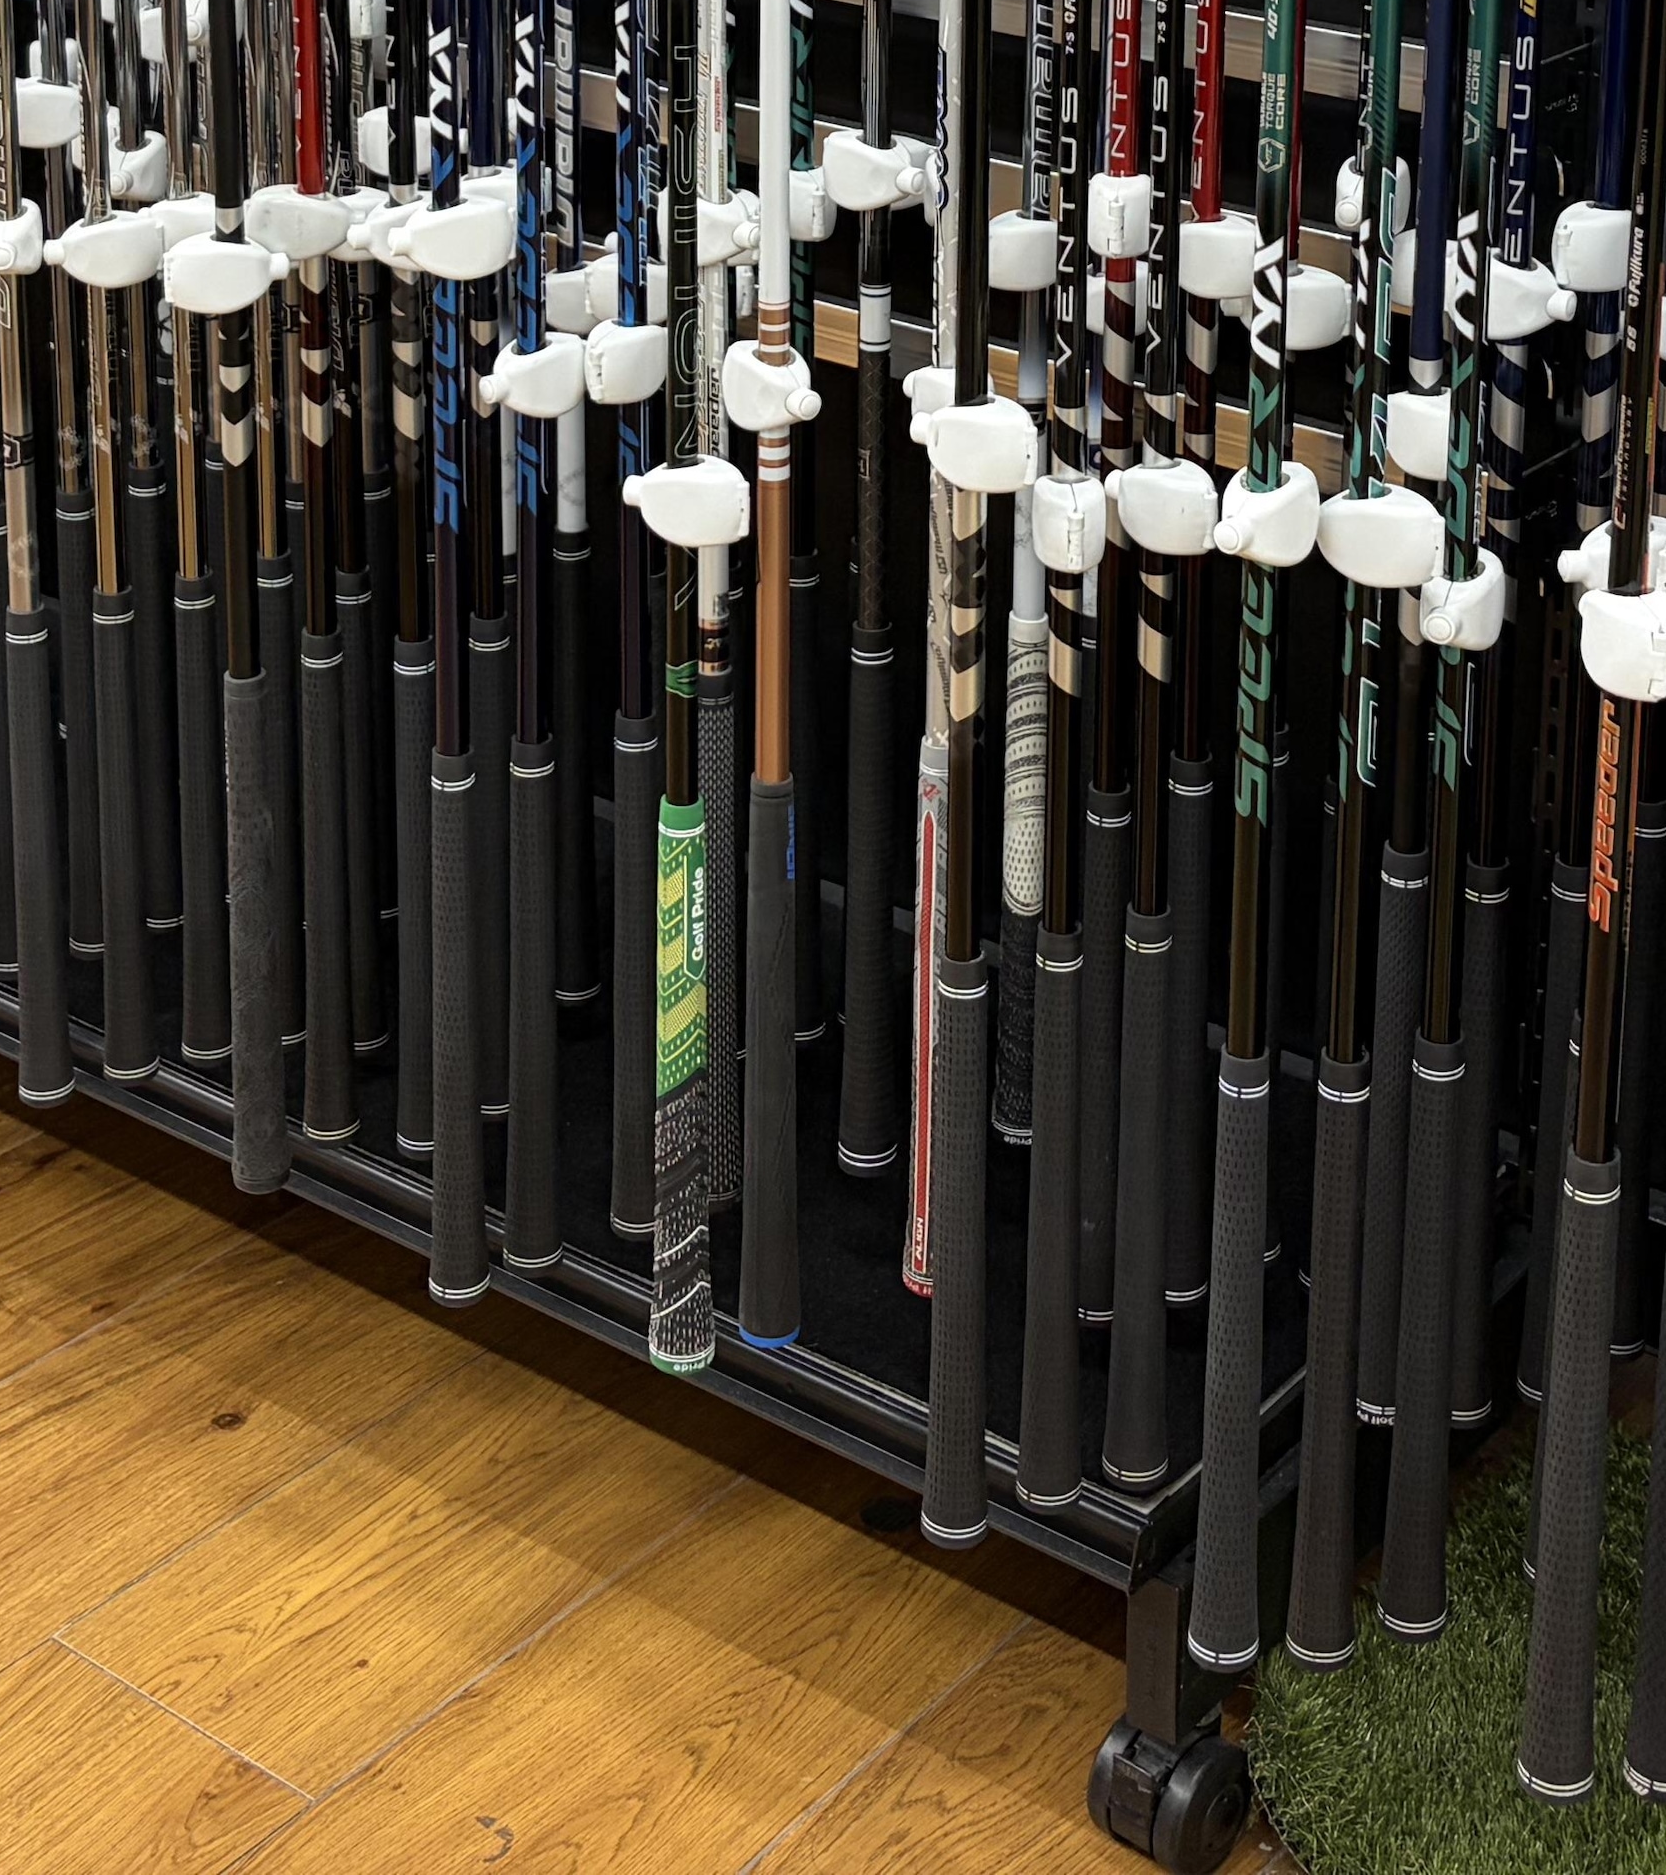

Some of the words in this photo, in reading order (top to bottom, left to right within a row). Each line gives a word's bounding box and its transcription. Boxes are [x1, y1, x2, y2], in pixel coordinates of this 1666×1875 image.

[1275, 73, 1287, 130] CORE
[1502, 34, 1534, 263] ENTUS
[1054, 86, 1078, 368] VENTUS
[1144, 75, 1169, 357] VENTUS
[1629, 226, 1644, 293] Fujikura
[690, 865, 706, 914] Pride
[690, 918, 706, 962] Golf
